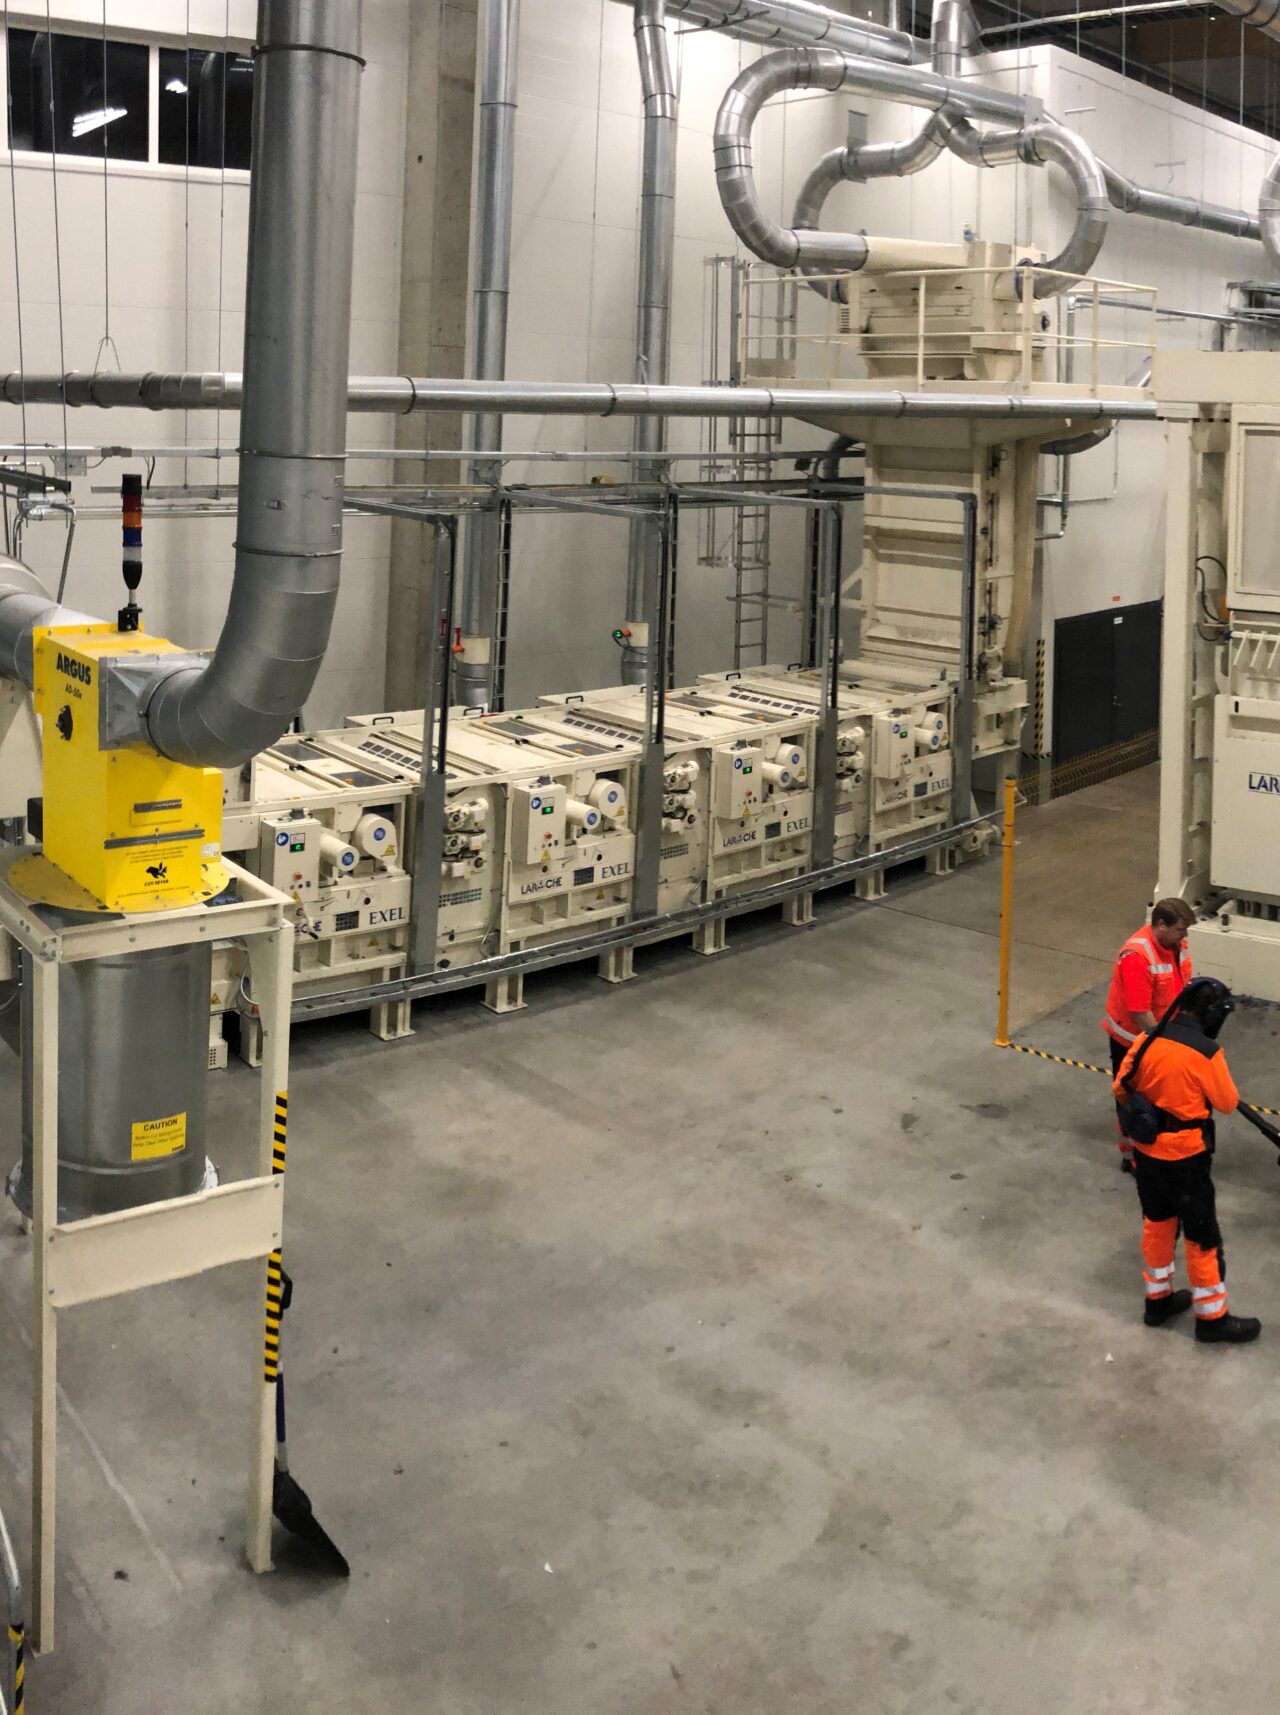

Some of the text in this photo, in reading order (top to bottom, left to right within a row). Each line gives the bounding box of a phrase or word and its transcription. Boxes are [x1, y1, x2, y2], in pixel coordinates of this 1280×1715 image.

[57, 653, 91, 685] ARGUS
[786, 818, 809, 832] EXEL
[601, 862, 630, 878] EXEL
[369, 907, 405, 925] EXEL
[143, 1118, 178, 1131] CAUTION
